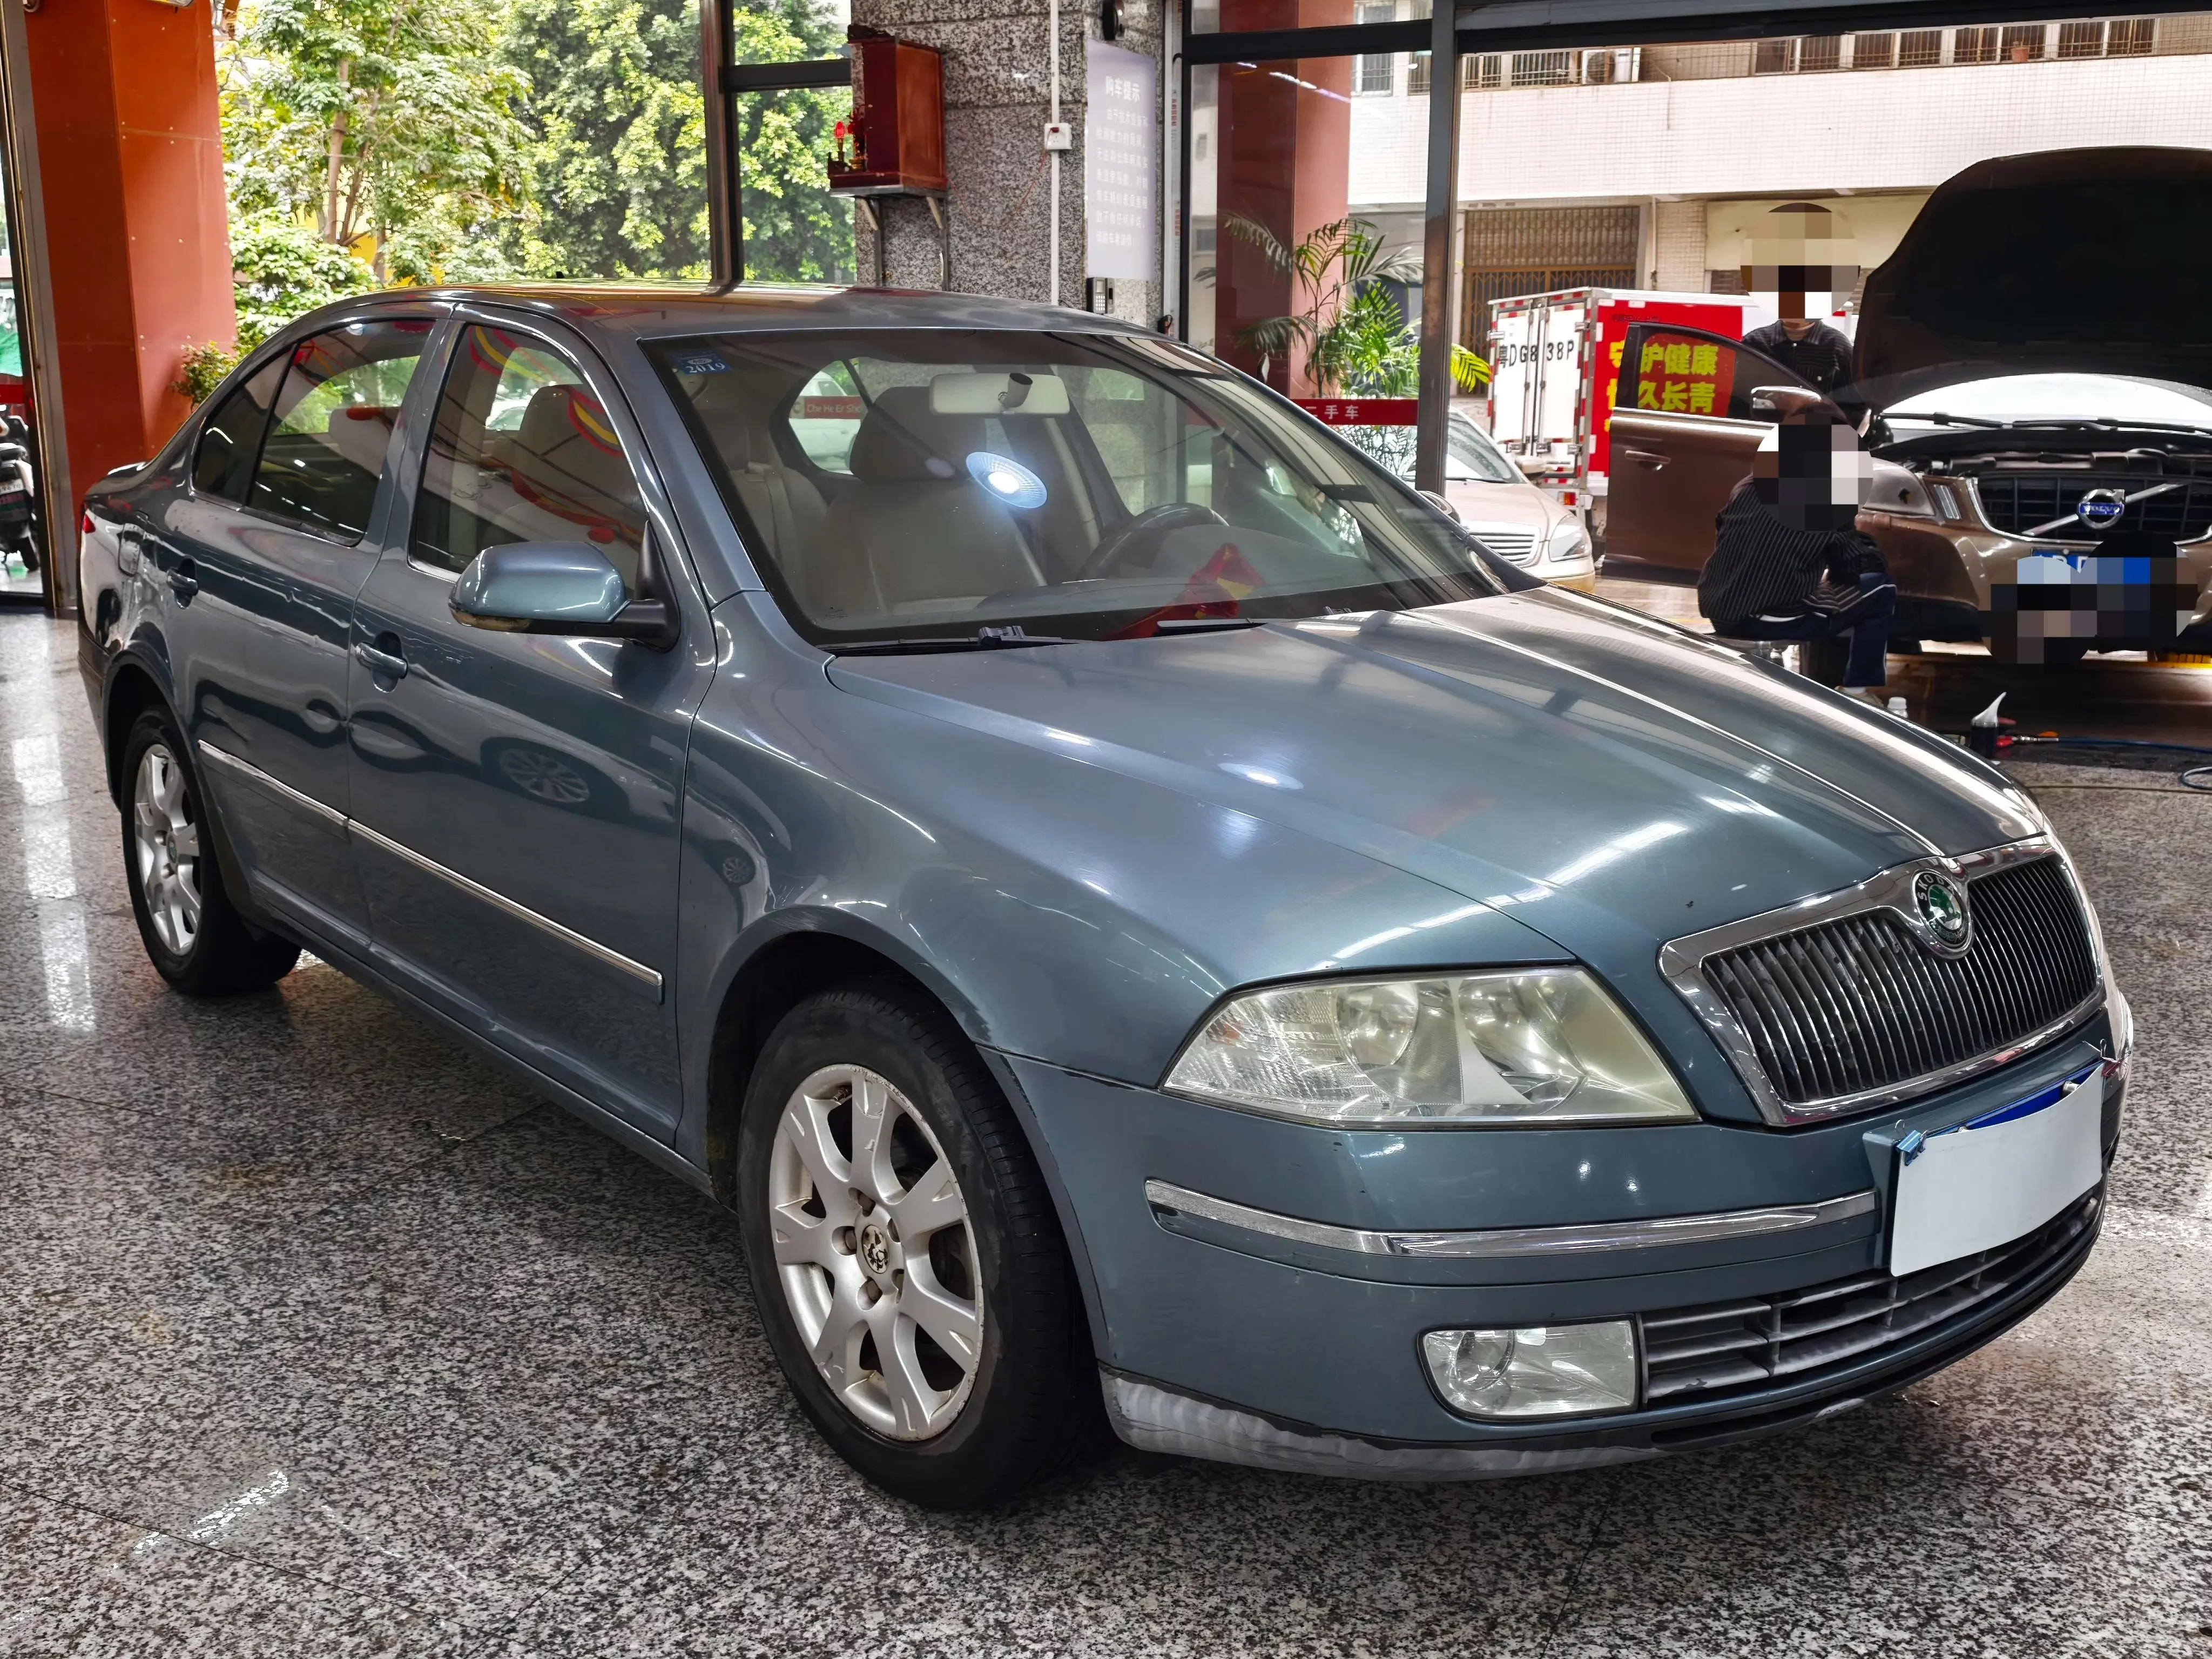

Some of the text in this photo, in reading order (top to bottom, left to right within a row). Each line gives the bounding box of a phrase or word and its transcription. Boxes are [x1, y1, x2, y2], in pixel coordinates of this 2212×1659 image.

[1105, 76, 1140, 102] 购车提示
[685, 362, 726, 374] 2019
